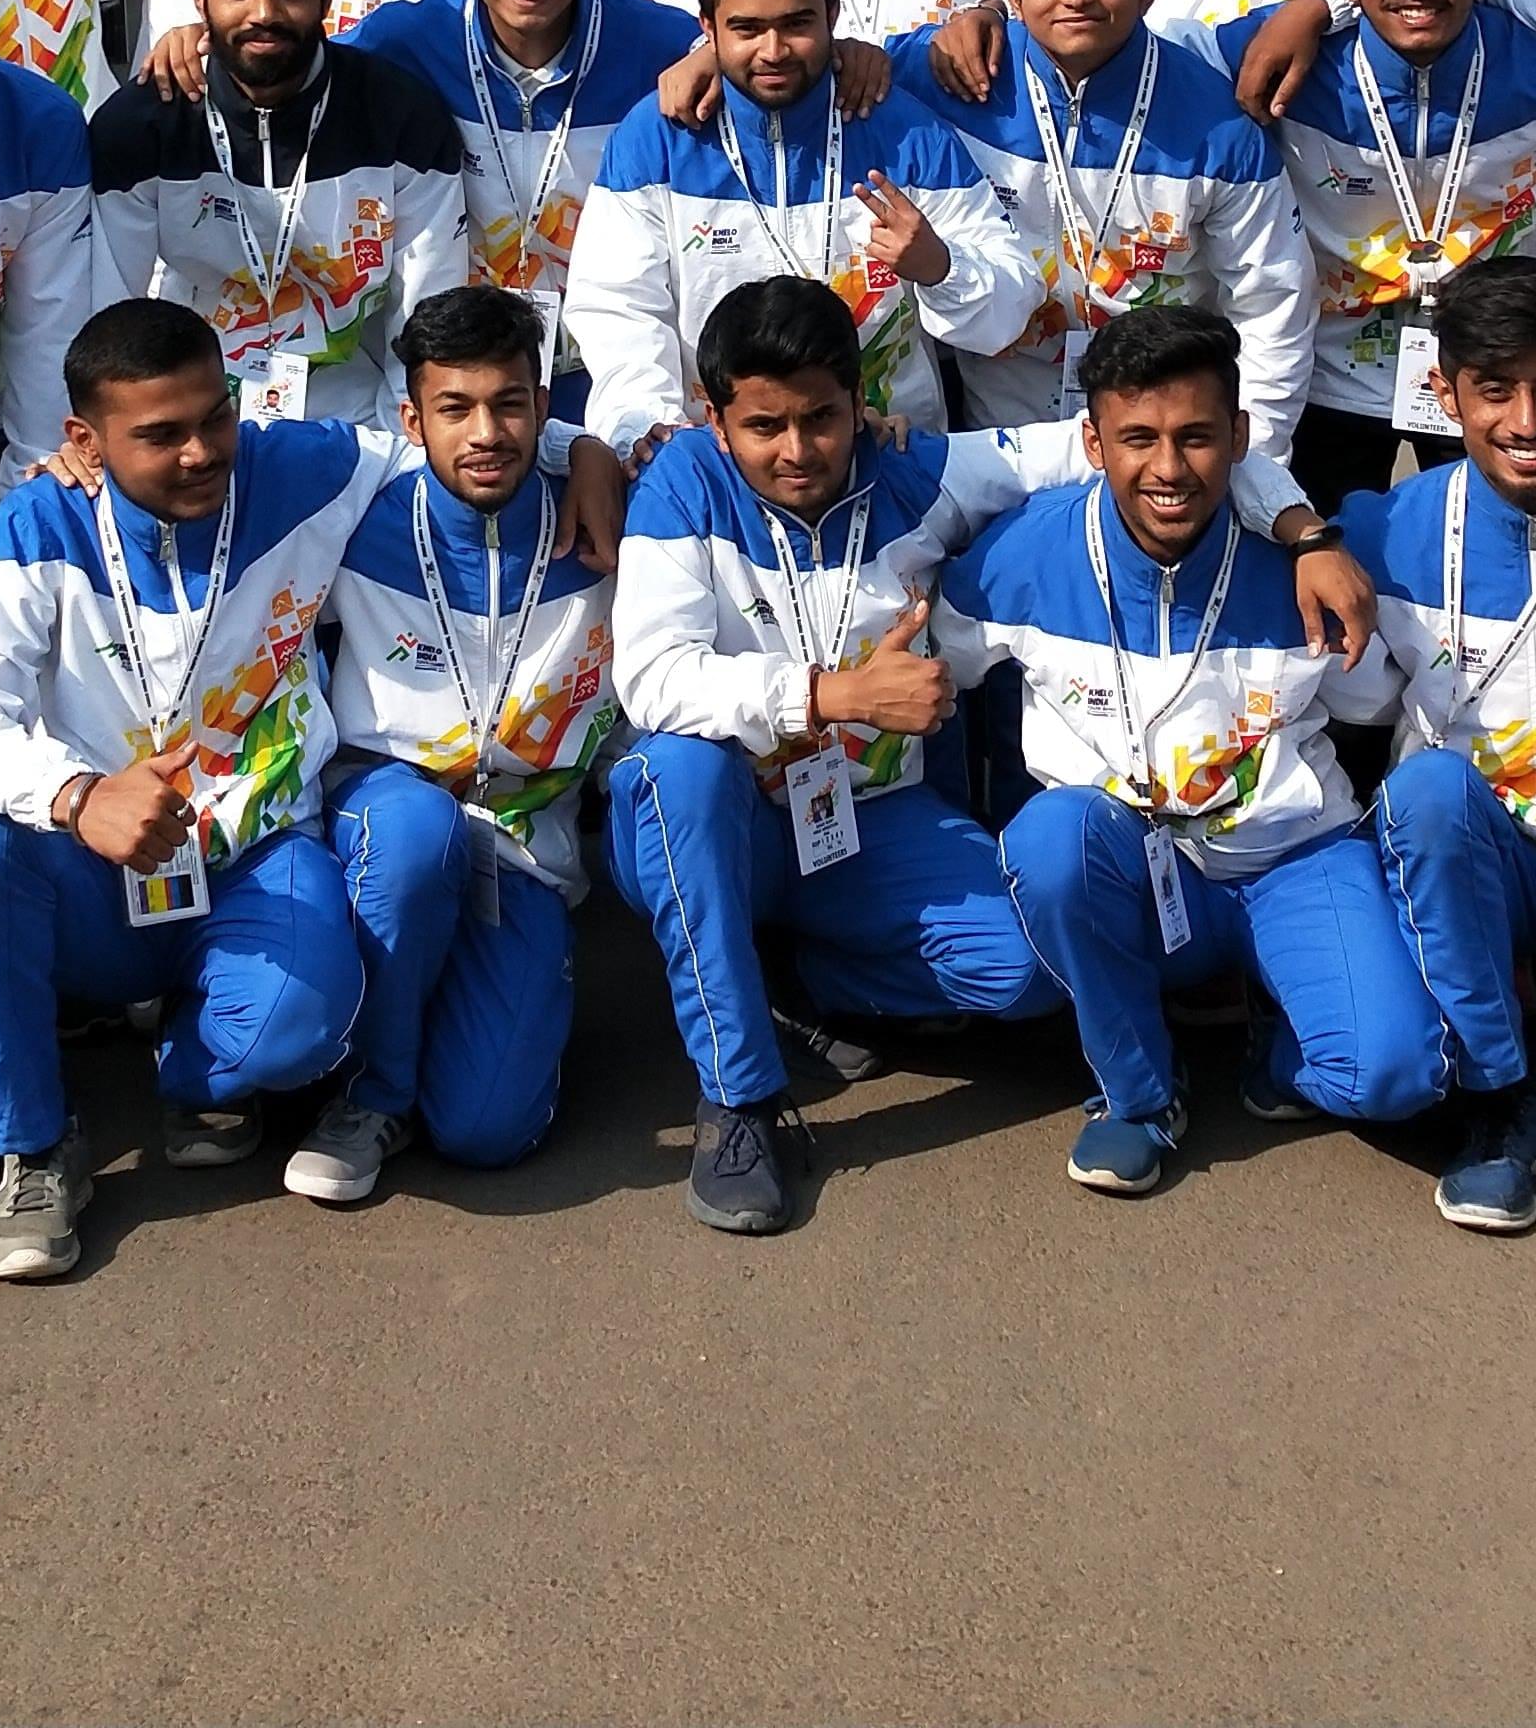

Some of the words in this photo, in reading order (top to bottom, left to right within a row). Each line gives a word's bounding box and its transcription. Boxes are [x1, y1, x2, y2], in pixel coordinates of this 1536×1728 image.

[712, 229, 737, 237] KHELO
[711, 237, 733, 245] INDIA
[1407, 421, 1448, 432] VOLUNTEERS
[1088, 688, 1114, 697] KHELO
[1087, 697, 1108, 706] INDIA
